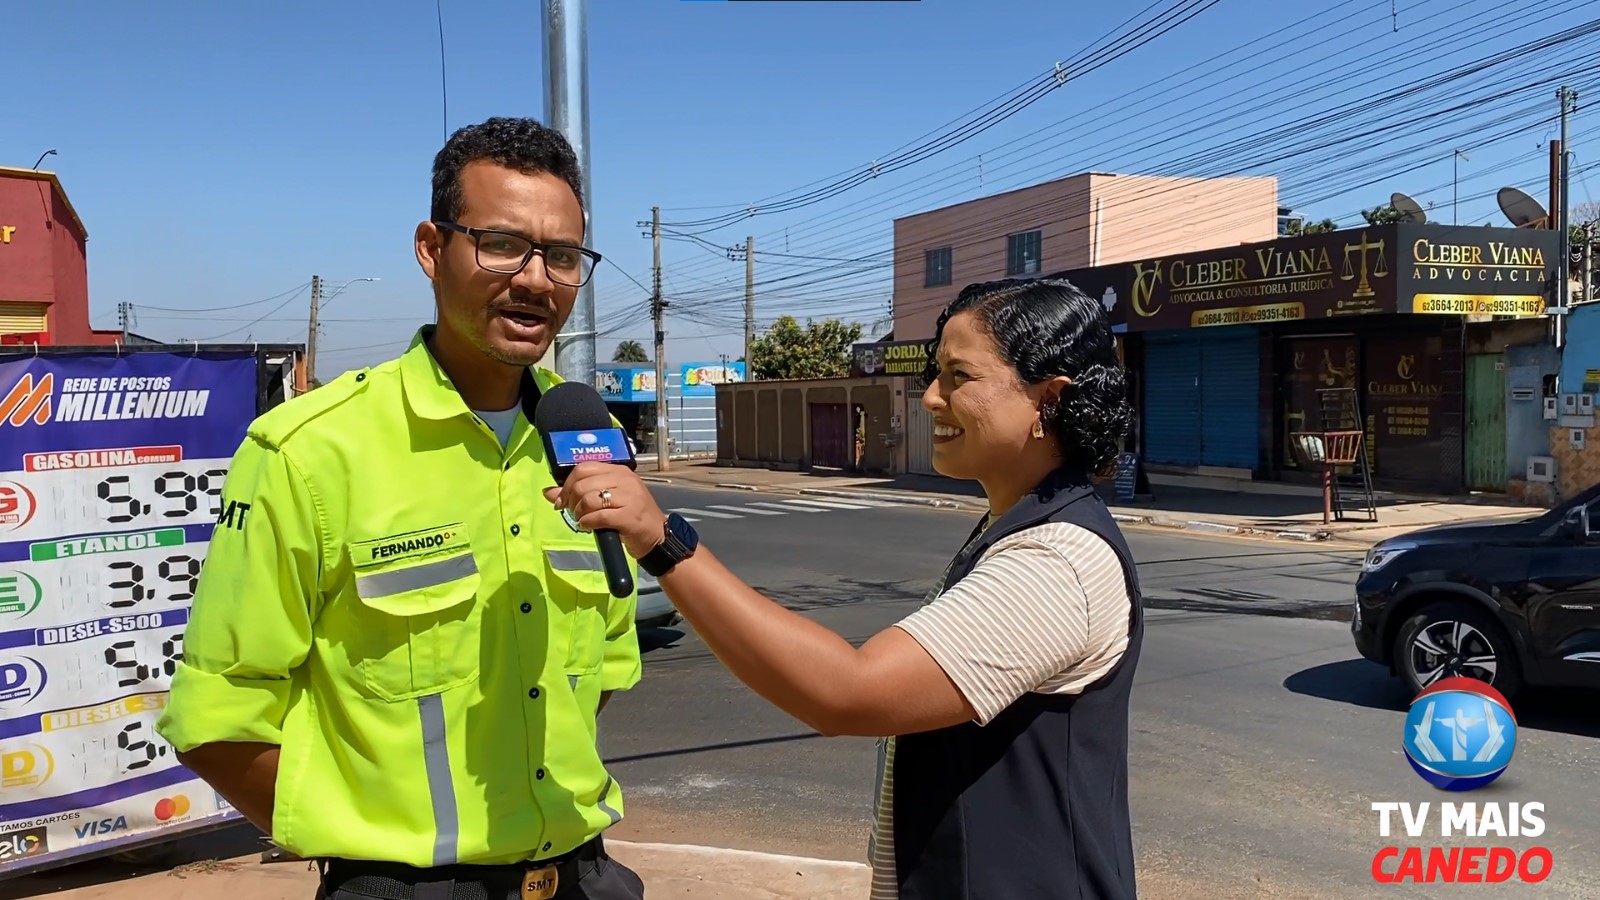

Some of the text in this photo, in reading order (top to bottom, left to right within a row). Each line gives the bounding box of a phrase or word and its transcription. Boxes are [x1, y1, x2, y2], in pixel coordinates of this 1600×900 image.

[1413, 239, 1544, 265] CLEBER VIANA
[1169, 247, 1333, 288] CLEBER VIANA
[1413, 267, 1546, 283] ADVOCACIA
[1169, 289, 1214, 304] ADVOCACIA
[1225, 283, 1287, 299] CONSULTORIA
[1289, 277, 1334, 293] JURÍDICA
[63, 376, 171, 392] REDE DE POSTOS
[1368, 381, 1408, 393] CLEBER
[55, 390, 210, 422] MILLENIUM
[33, 450, 136, 470] GASOLINA
[572, 452, 614, 461] CANEDO
[56, 533, 161, 557] ETANOL
[372, 534, 443, 559] FERNANDO
[43, 613, 163, 645] DIESEL-S500
[2, 750, 36, 778] D
[35, 812, 81, 826] CARTÕES
[73, 815, 129, 840] VISA
[527, 878, 554, 891] SMT
